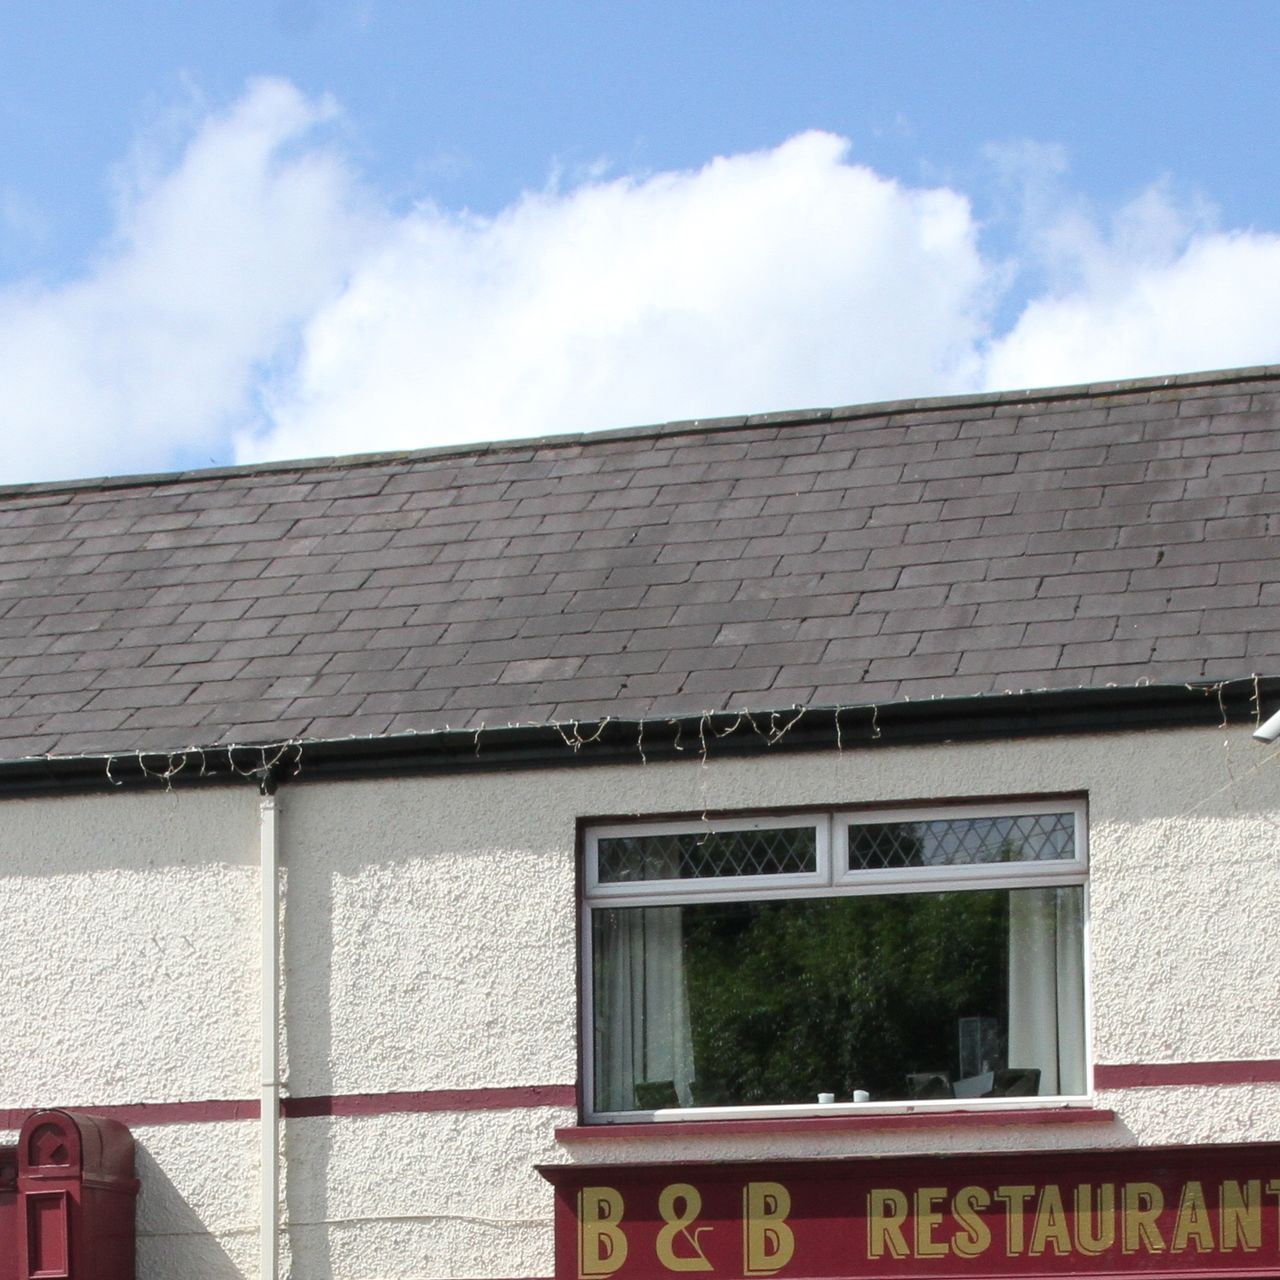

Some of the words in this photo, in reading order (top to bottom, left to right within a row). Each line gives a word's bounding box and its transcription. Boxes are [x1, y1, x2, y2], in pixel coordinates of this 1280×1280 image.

[577, 1186, 629, 1280] B
[655, 1183, 714, 1272] &
[742, 1181, 796, 1277] B
